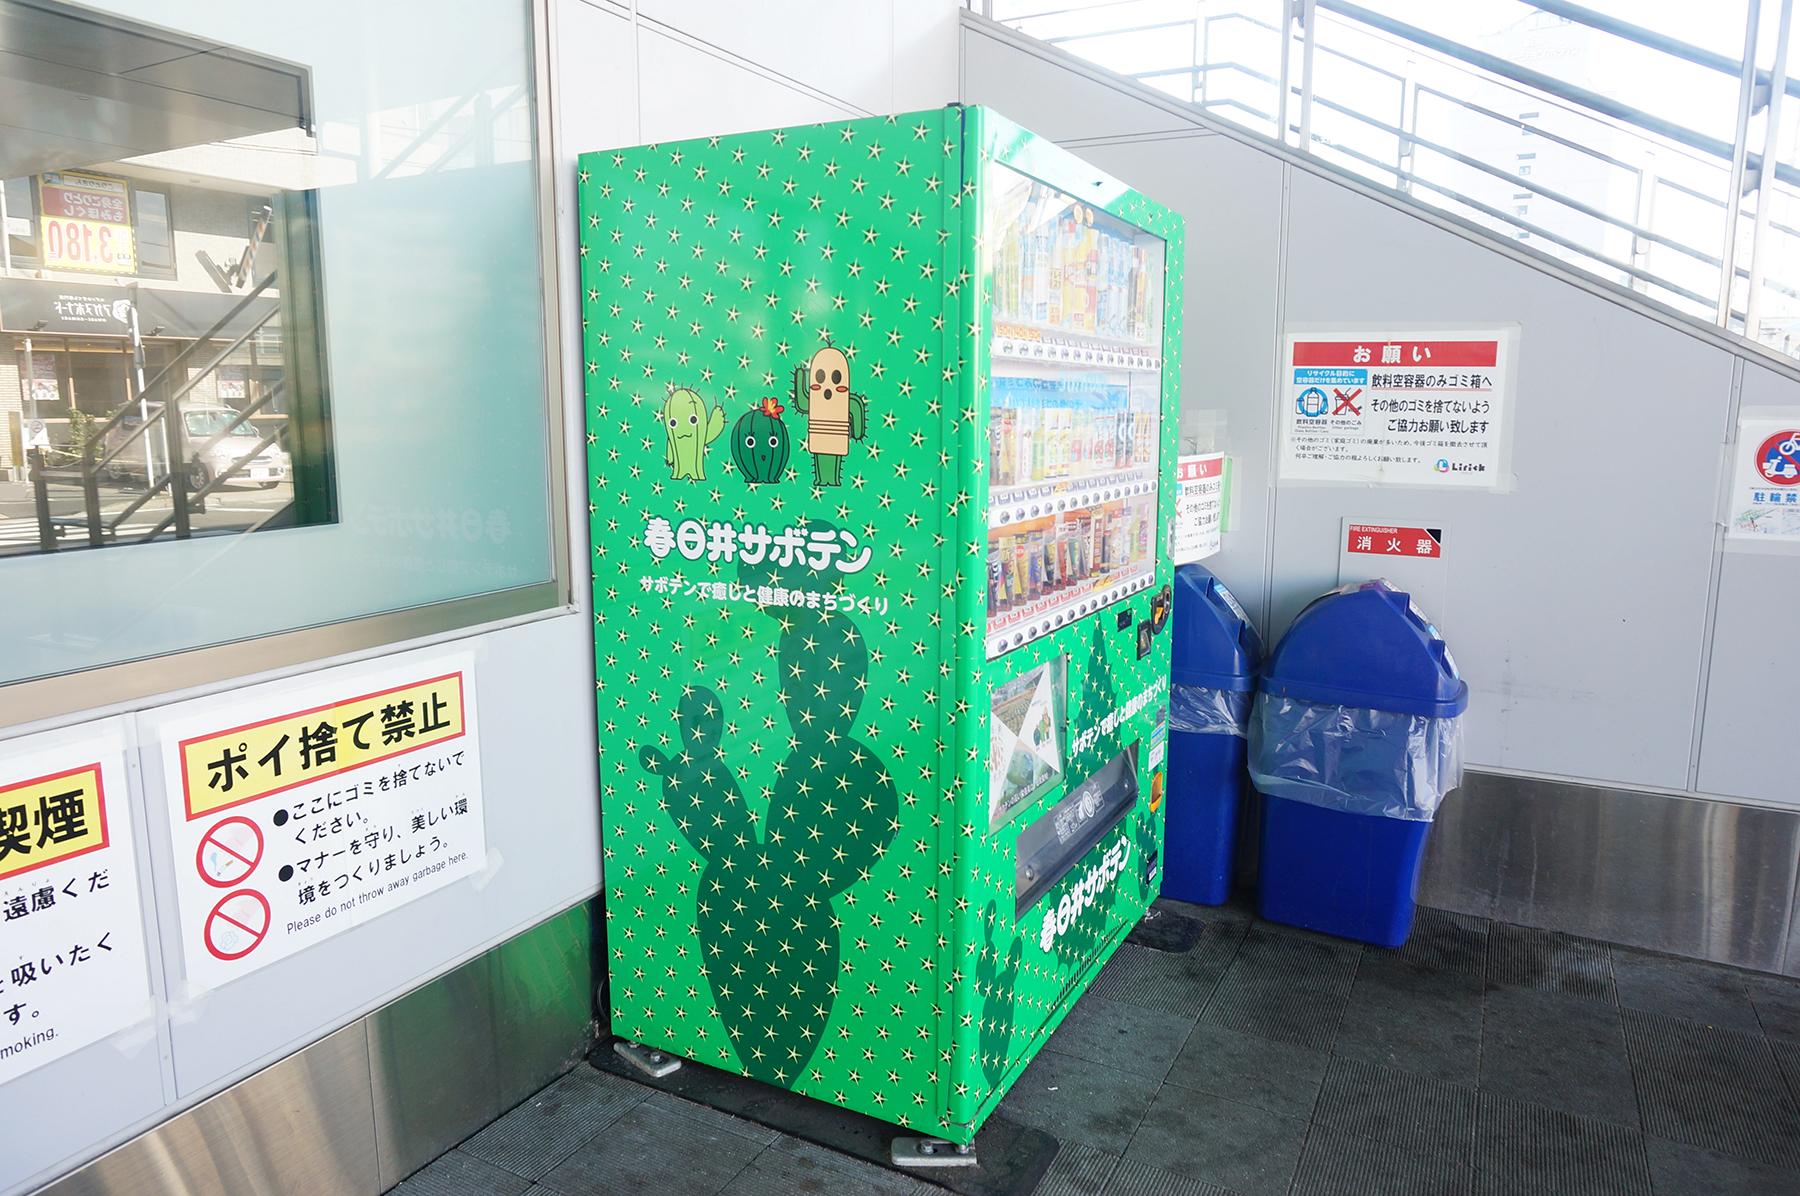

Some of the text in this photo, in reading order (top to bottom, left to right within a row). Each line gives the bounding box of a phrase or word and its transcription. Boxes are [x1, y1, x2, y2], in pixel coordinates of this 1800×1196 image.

[1353, 345, 1431, 364] お願い
[1371, 374, 1493, 389] 飲料空容器のみゴミ箱へ
[1371, 399, 1490, 414] その他のゴミを捨てないよう
[1388, 418, 1489, 434] ご協力お願い致します
[643, 516, 873, 574] 春日井サボテン
[1356, 535, 1432, 554] 消火器
[640, 576, 889, 616] サボテンで癒しと健康のまちづくり
[207, 692, 451, 793] ポイ捨て禁止
[295, 812, 369, 845] ください。
[298, 836, 448, 906] 境をつくりましょう。
[287, 851, 469, 935] Please do not throw away garbage here.
[1039, 835, 1131, 953] 春日井サボテン
